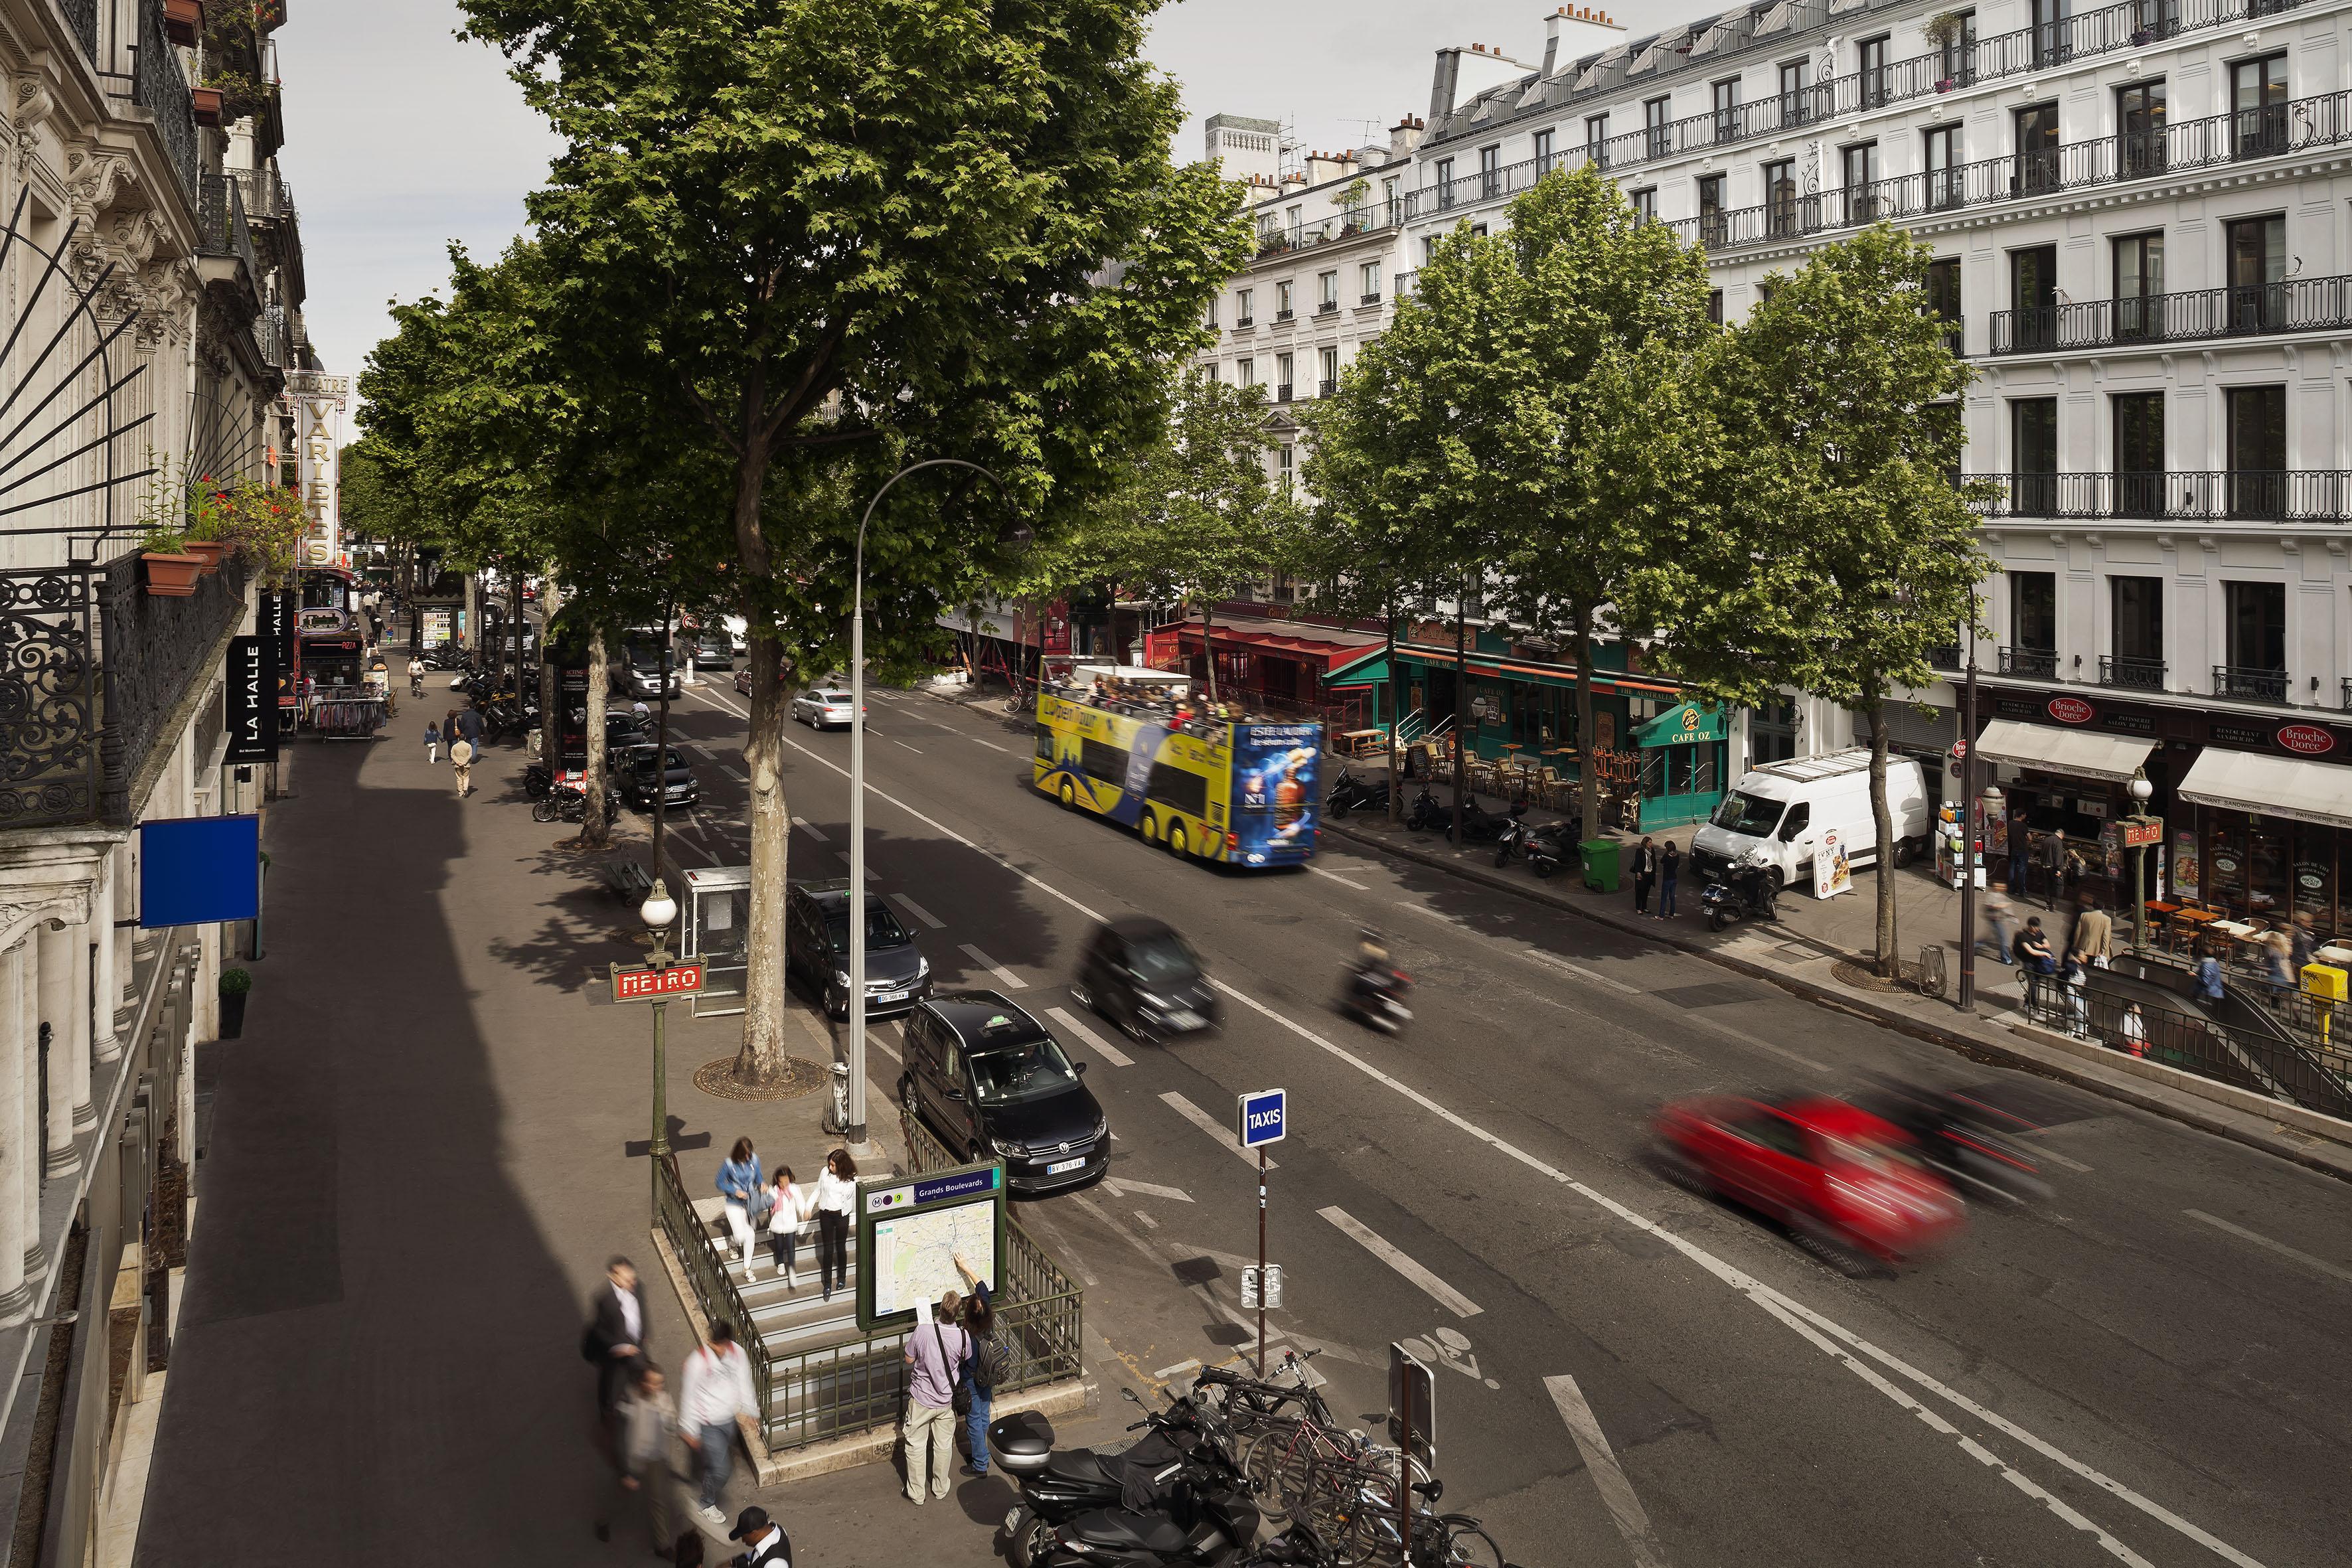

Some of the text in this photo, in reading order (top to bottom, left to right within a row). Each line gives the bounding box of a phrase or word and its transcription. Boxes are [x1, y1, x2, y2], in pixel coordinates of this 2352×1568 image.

[305, 402, 334, 562] VARIETES
[247, 647, 259, 740] LA HALLE
[2055, 700, 2087, 713] Brioche
[2059, 710, 2082, 720] Dorée
[1672, 732, 1711, 742] CAFE OZ
[2286, 728, 2327, 744] Brioche
[2291, 740, 2320, 751] Dorée
[2007, 757, 2036, 767] SANDWICHS
[2063, 767, 2092, 775] PATISSERIE
[2181, 793, 2261, 811] RESTAURANT SANDWICHS
[2295, 811, 2333, 823] PATISSERIE
[2128, 826, 2157, 842] METRO
[623, 970, 696, 994] METRO
[1249, 1108, 1281, 1129] TAXIS
[919, 1179, 983, 1198] Grands Boulevards
